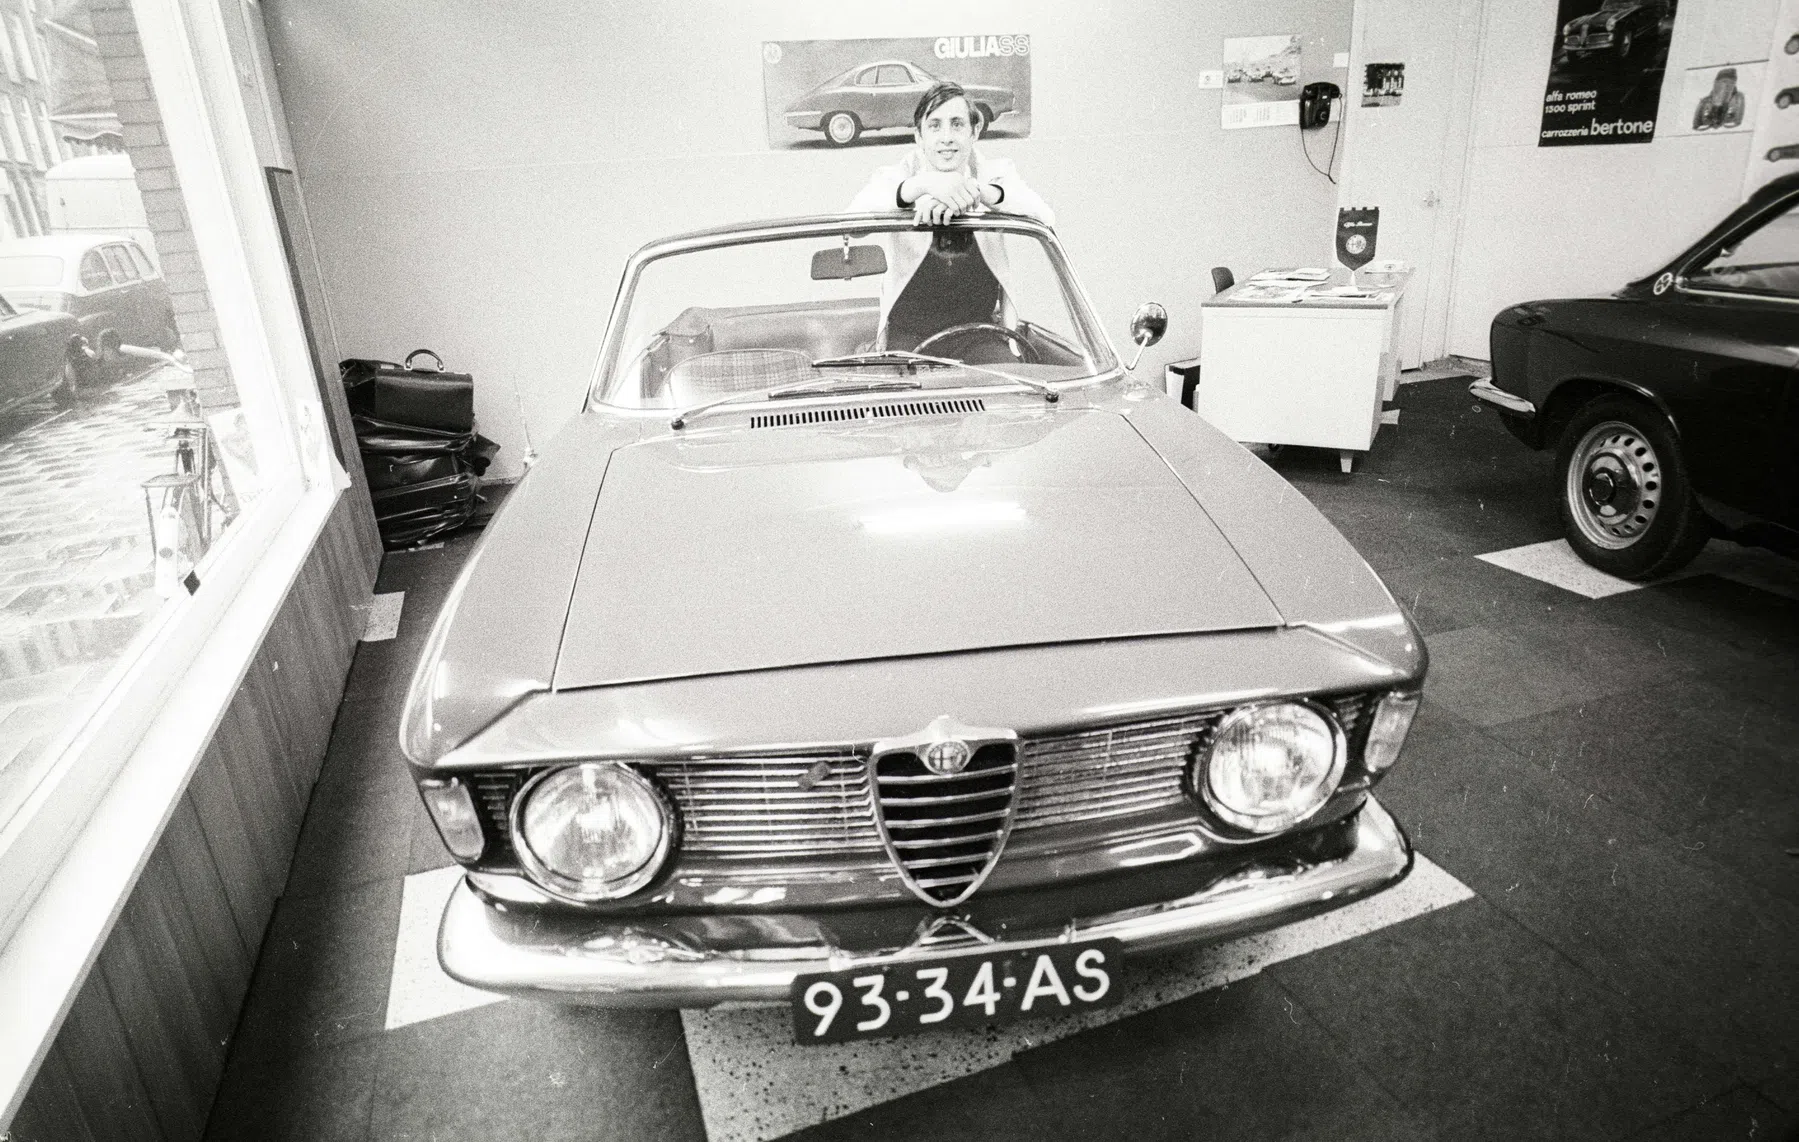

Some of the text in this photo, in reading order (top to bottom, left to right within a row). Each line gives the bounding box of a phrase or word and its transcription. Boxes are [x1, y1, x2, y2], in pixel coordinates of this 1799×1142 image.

[1546, 90, 1597, 102] alfa romeo
[1545, 100, 1596, 114] 1300 sprint
[1541, 118, 1653, 138] carrozzeria bertone
